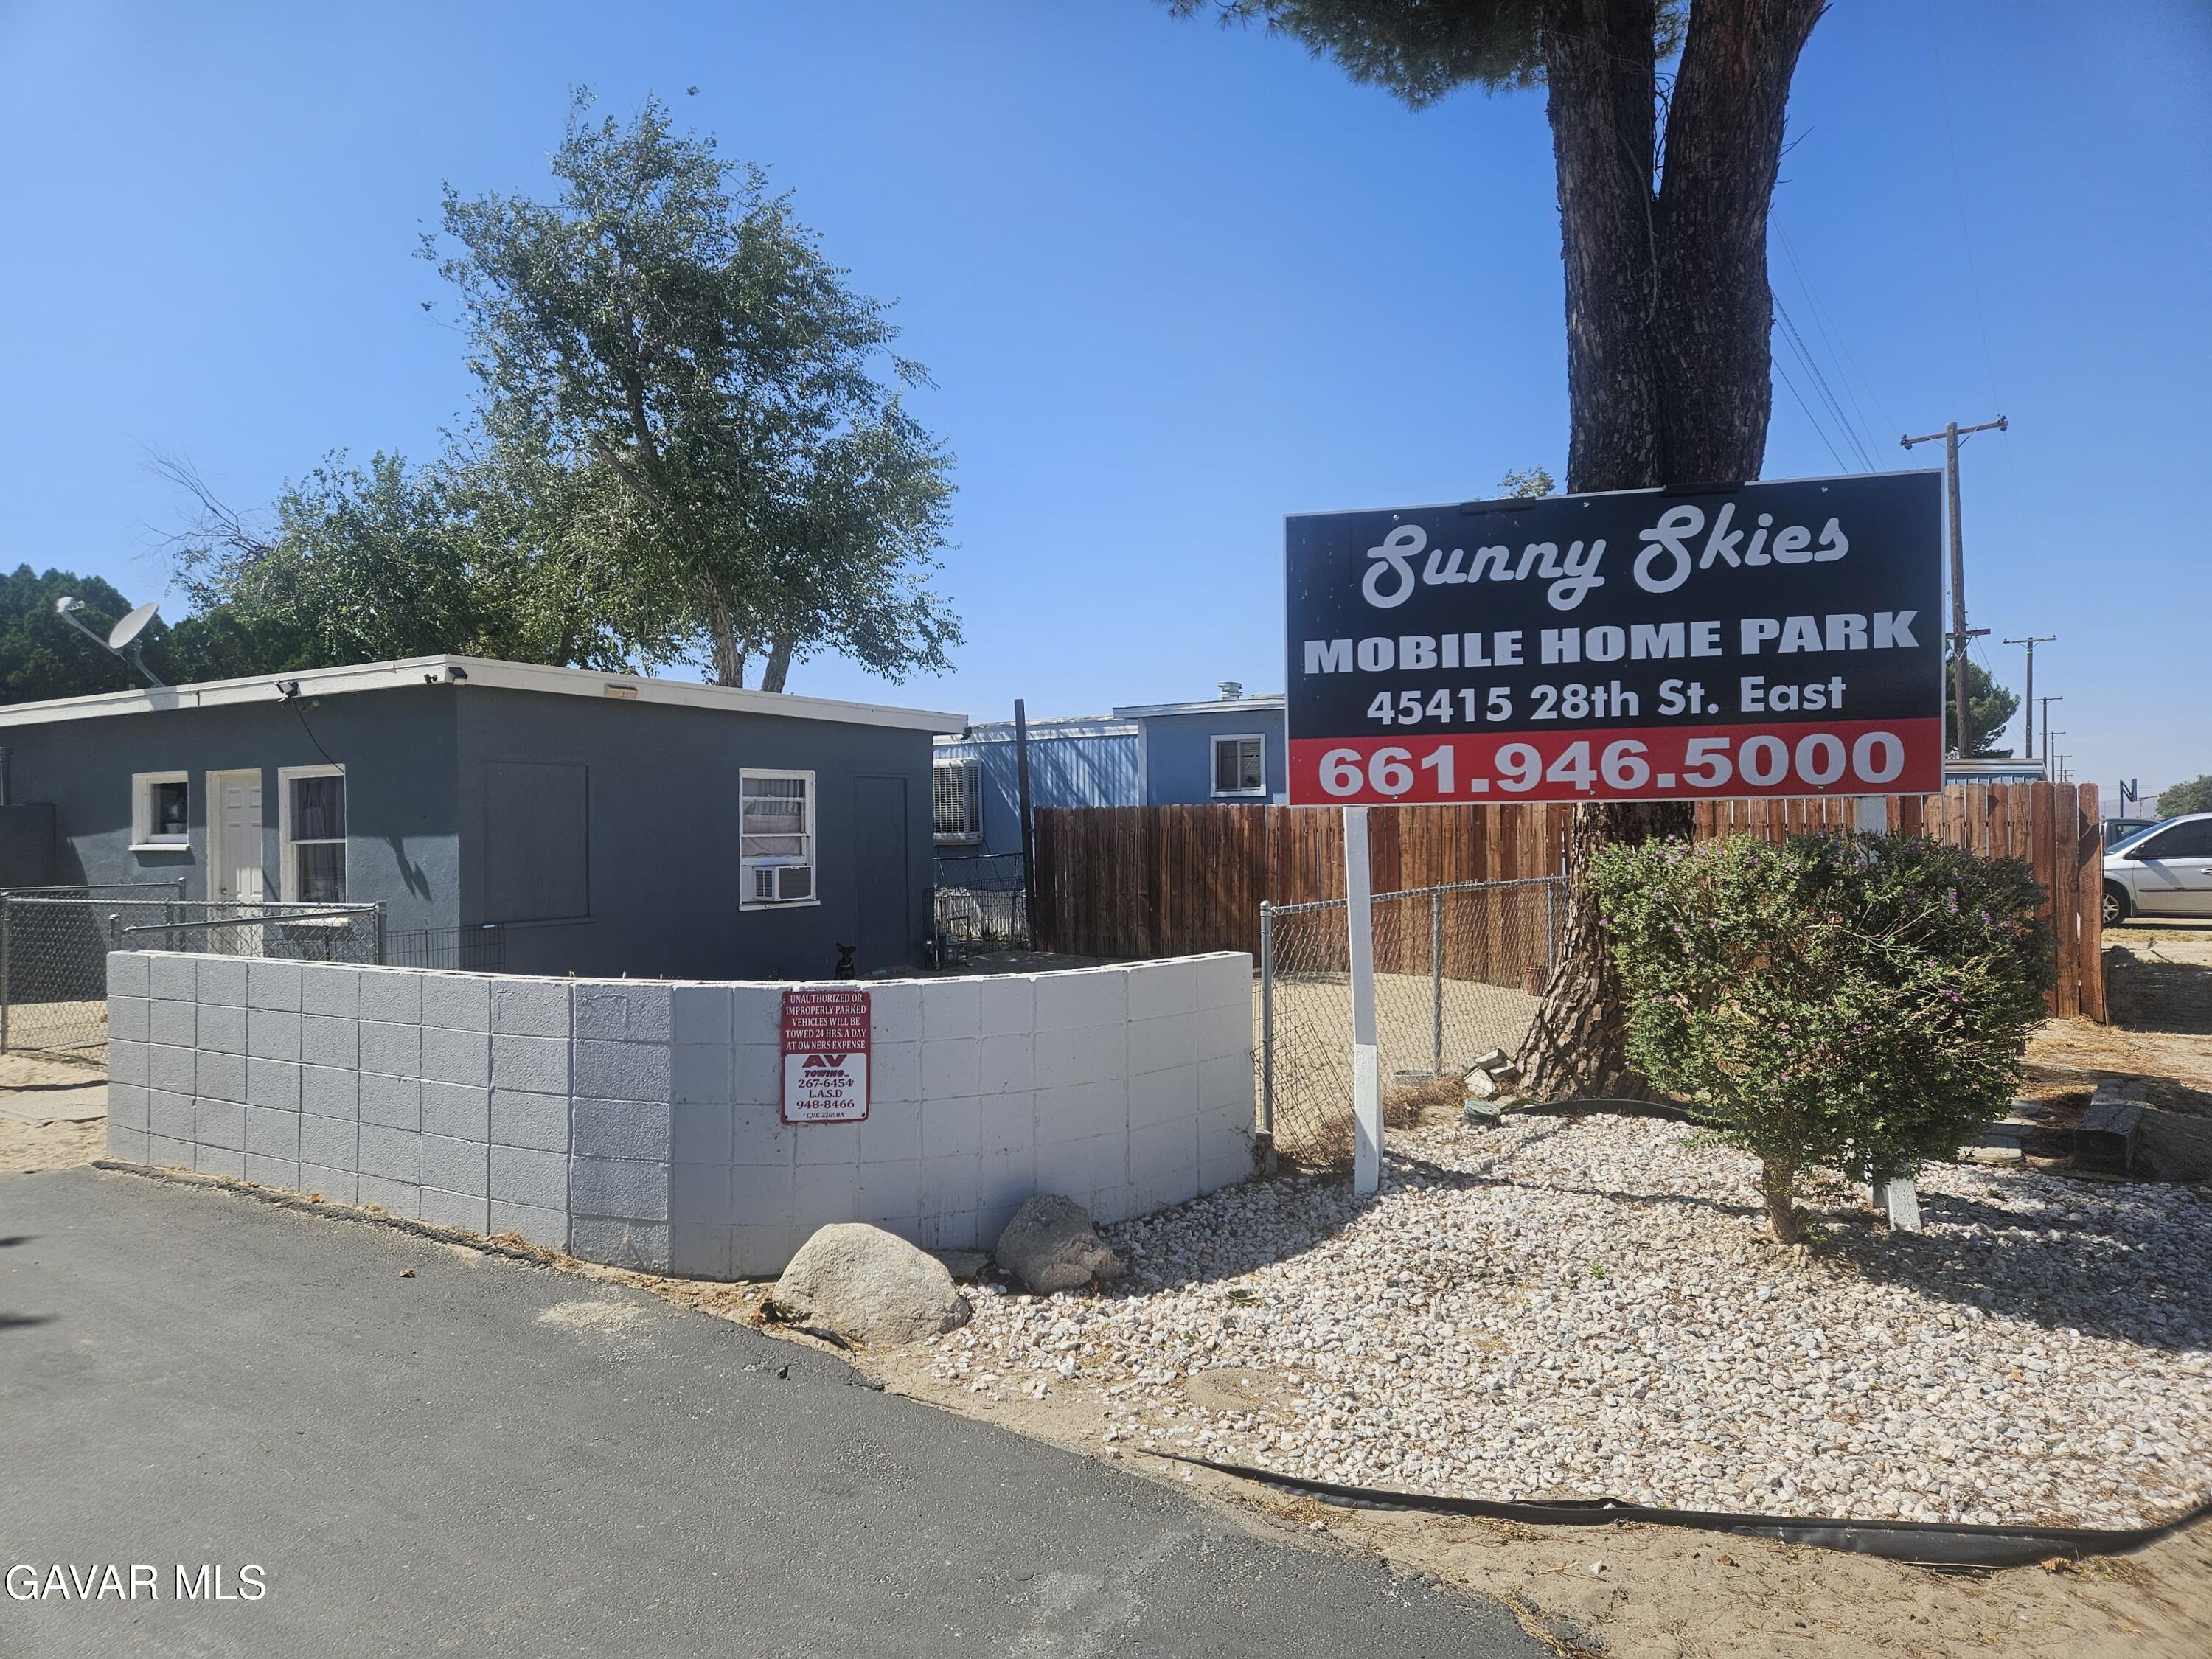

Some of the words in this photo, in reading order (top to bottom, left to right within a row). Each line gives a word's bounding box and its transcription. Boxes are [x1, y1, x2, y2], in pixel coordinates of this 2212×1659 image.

[1361, 524, 1607, 611] Sunny
[1632, 501, 1850, 593] Skies
[1304, 630, 1523, 675] MOBILE
[1540, 620, 1722, 666] HOME
[1741, 609, 1919, 655] PARK
[1366, 686, 1513, 726] 45415
[1530, 680, 1640, 720] 28th
[1658, 678, 1719, 715] St.
[1740, 675, 1846, 713] East
[1318, 730, 1905, 797] 661.946.5000
[790, 994, 849, 1004] UNAUTHORIZED
[852, 993, 862, 1002] OR
[786, 1006, 833, 1015] IMPROPERLY
[835, 1005, 866, 1014] PARKED
[792, 1018, 827, 1026] VEHICLES
[830, 1017, 849, 1026] WILL
[850, 1017, 860, 1026] BE
[785, 1029, 814, 1038] TOWED
[815, 1029, 824, 1037] 24
[826, 1029, 843, 1037] HRS.
[844, 1029, 849, 1037] A
[851, 1029, 866, 1037] DAY
[786, 1041, 796, 1050] AT
[798, 1040, 830, 1050] OWNERS
[832, 1040, 866, 1049] EXPENSE
[802, 1054, 847, 1068] AV
[804, 1069, 844, 1078] TOWING
[798, 1079, 854, 1088] 267-6454
[796, 1100, 855, 1109] 948-8466
